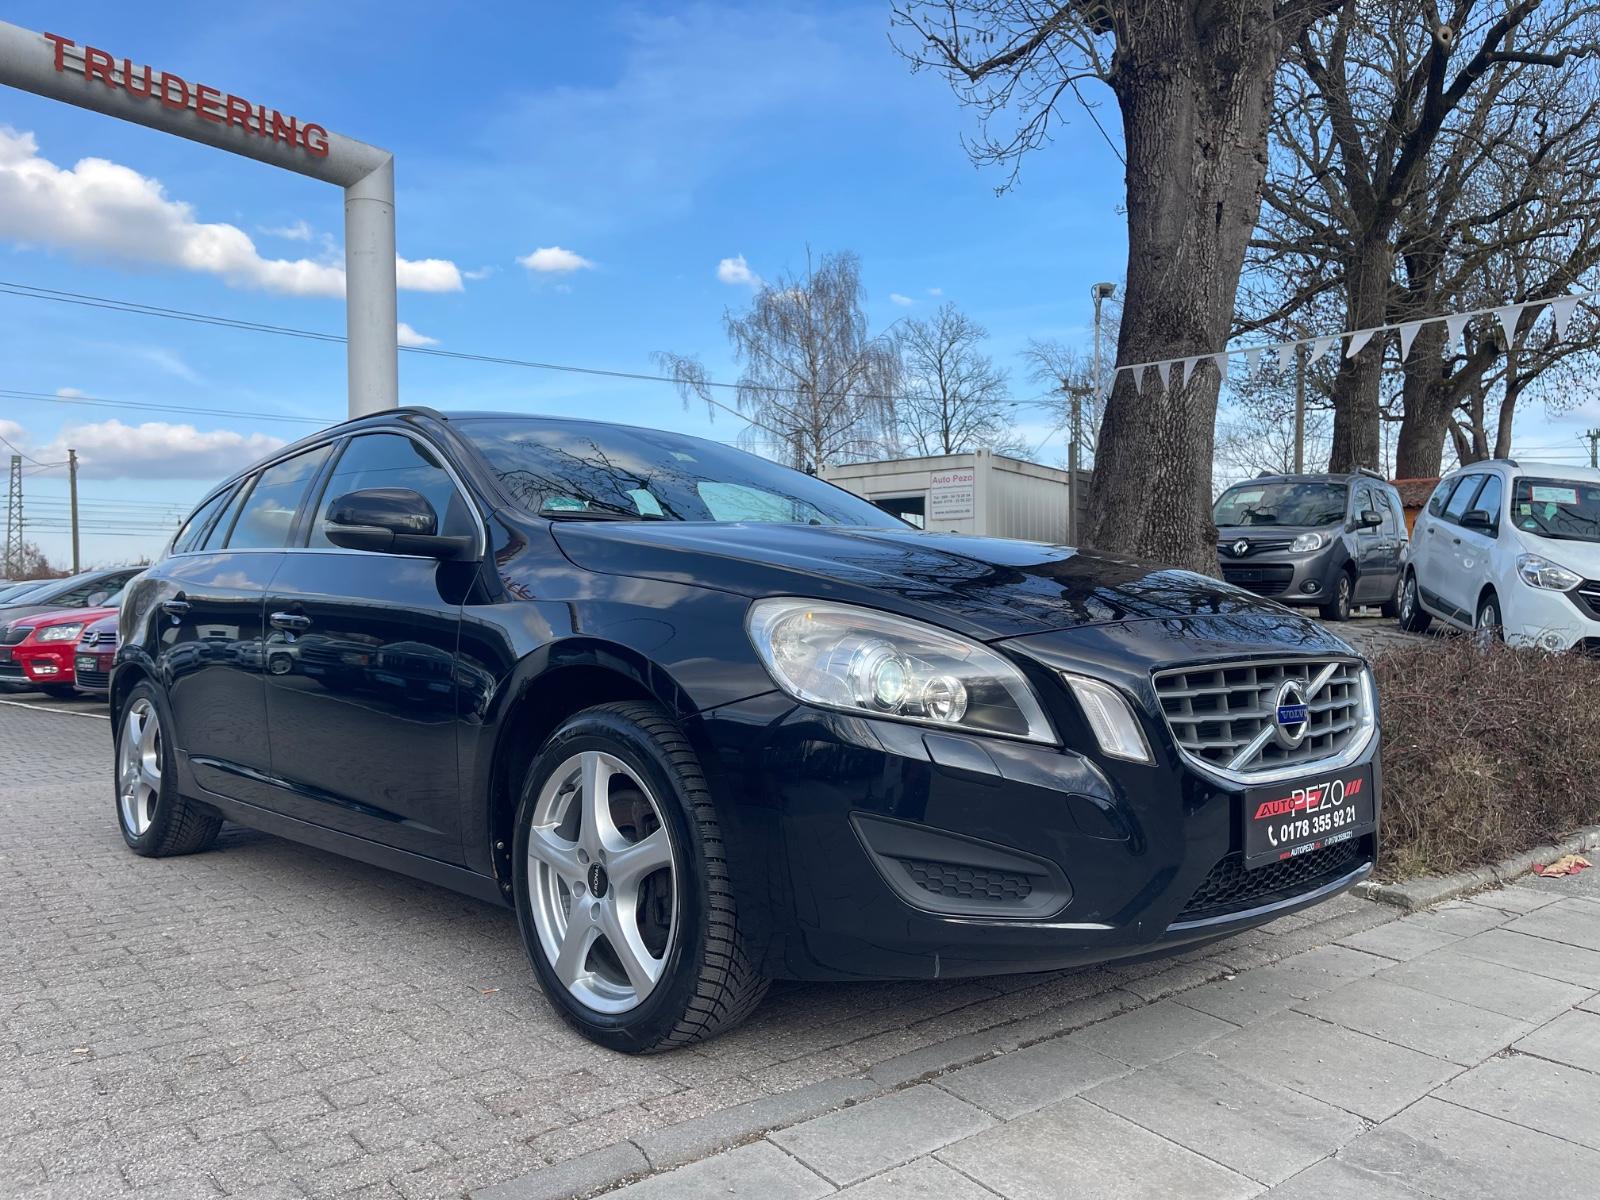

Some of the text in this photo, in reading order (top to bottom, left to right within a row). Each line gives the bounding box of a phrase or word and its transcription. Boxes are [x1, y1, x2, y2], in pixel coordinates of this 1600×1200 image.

[44, 31, 329, 158] TRUDERING
[933, 474, 973, 484] Auto Pezo
[1260, 779, 1345, 817] AUTO PEZO
[1280, 819, 1310, 842] 0178
[1312, 813, 1332, 834] 355
[1333, 808, 1345, 828] 92
[1346, 805, 1356, 823] 21
